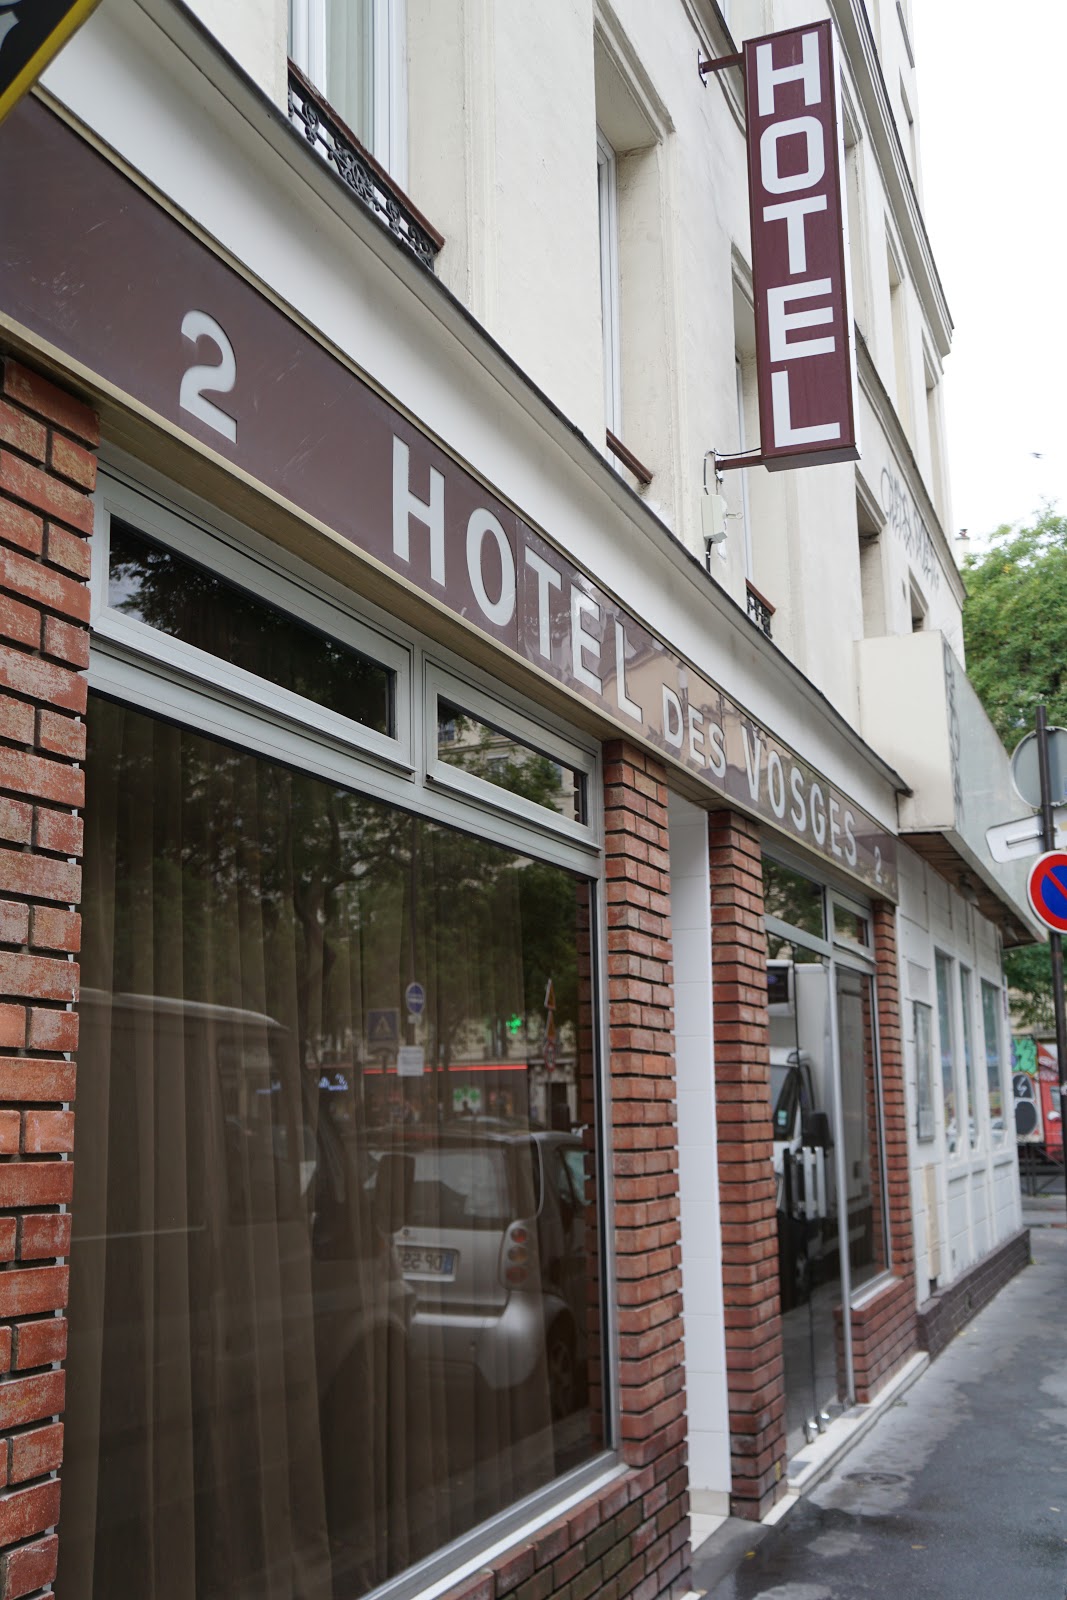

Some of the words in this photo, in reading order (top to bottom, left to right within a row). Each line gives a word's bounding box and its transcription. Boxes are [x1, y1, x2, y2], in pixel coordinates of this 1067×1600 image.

[756, 31, 841, 448] HOTEL
[179, 309, 238, 444] 2
[391, 433, 643, 725] HOTEL
[662, 682, 727, 779] DES
[741, 722, 858, 867] VOSGES
[873, 845, 883, 884] 2
